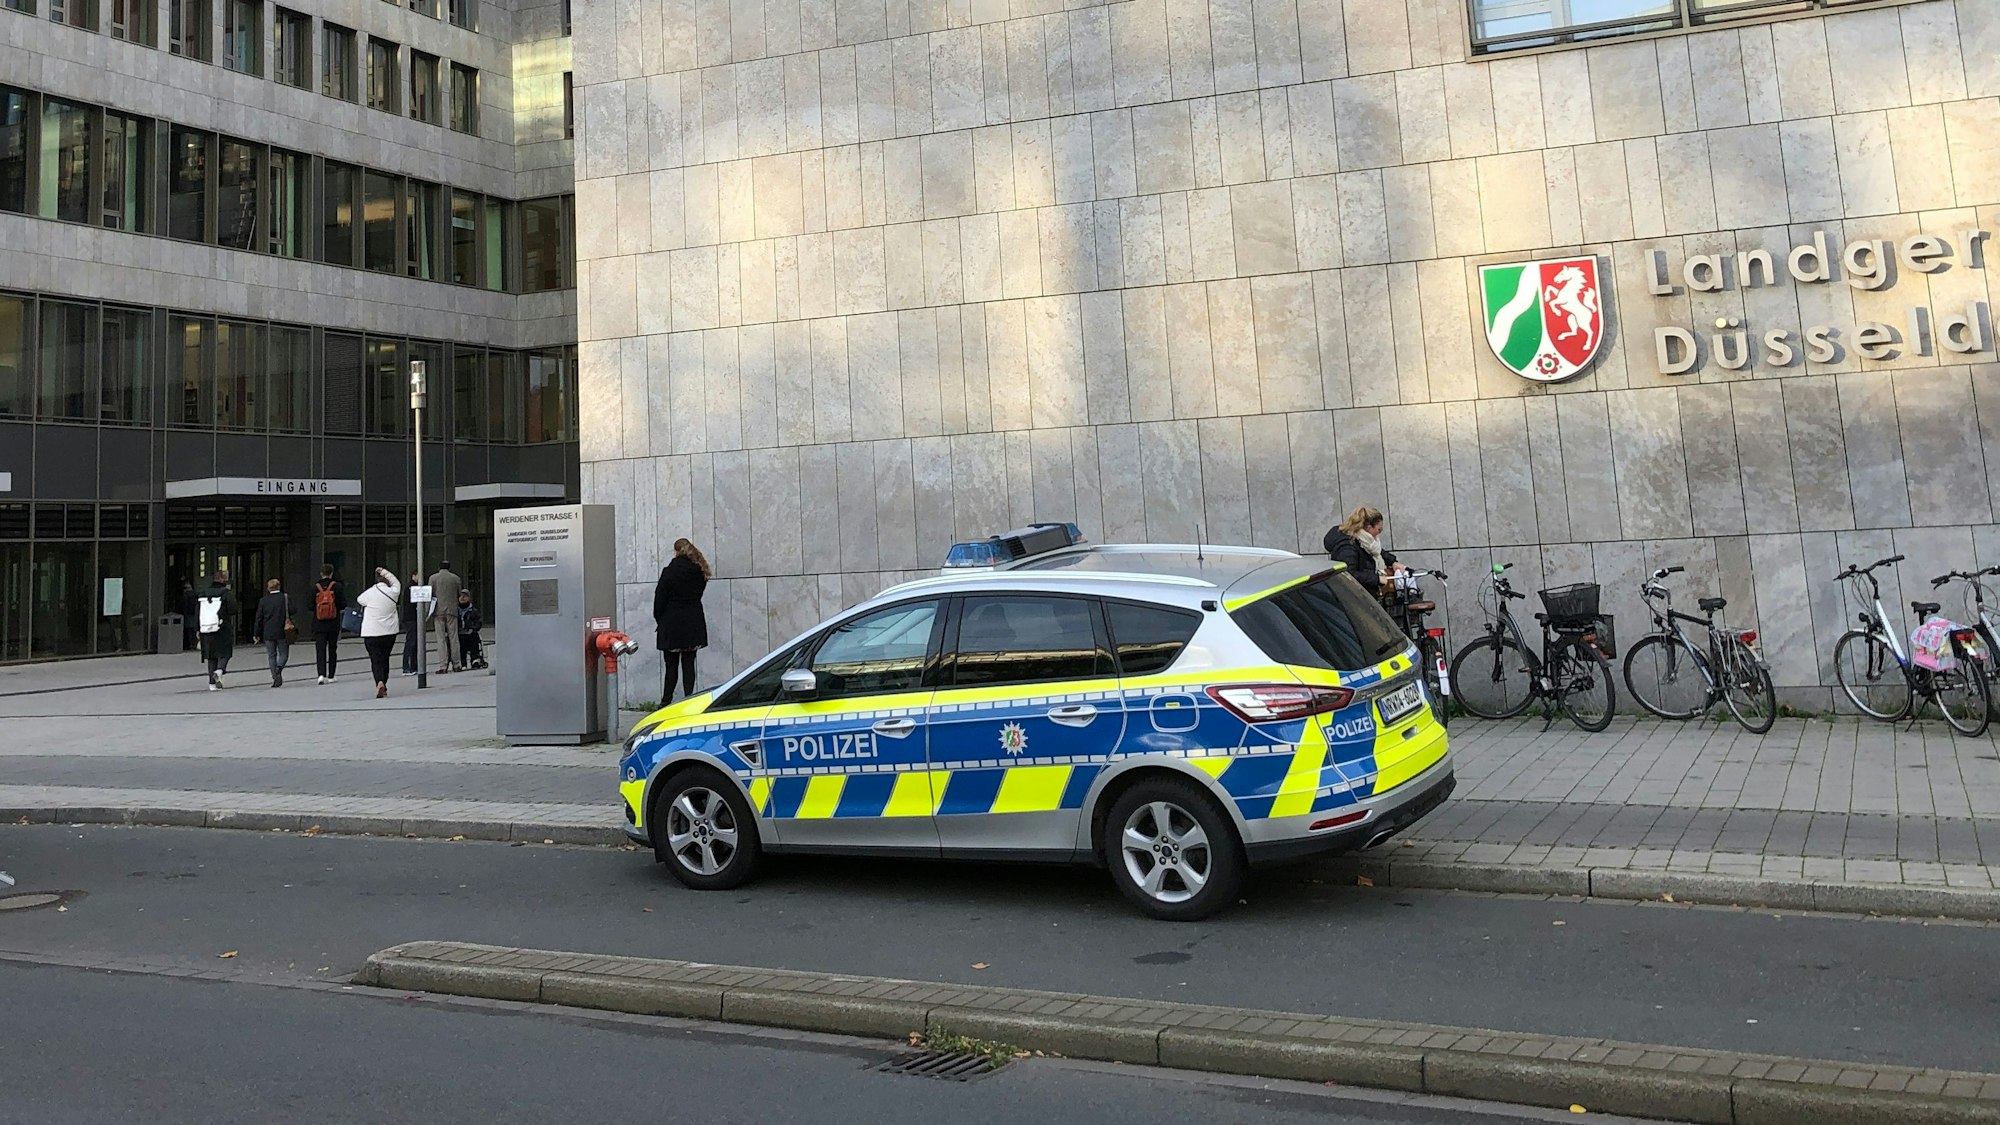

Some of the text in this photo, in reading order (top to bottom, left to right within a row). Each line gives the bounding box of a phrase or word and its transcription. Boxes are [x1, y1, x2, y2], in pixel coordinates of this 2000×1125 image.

[1654, 301, 2000, 374] Düsseld
[257, 481, 327, 492] EINGANG
[499, 514, 539, 524] WERDENER
[540, 512, 573, 521] STRASSE
[1325, 716, 1374, 742] POLIZEI
[783, 733, 878, 761] POLIZEI
